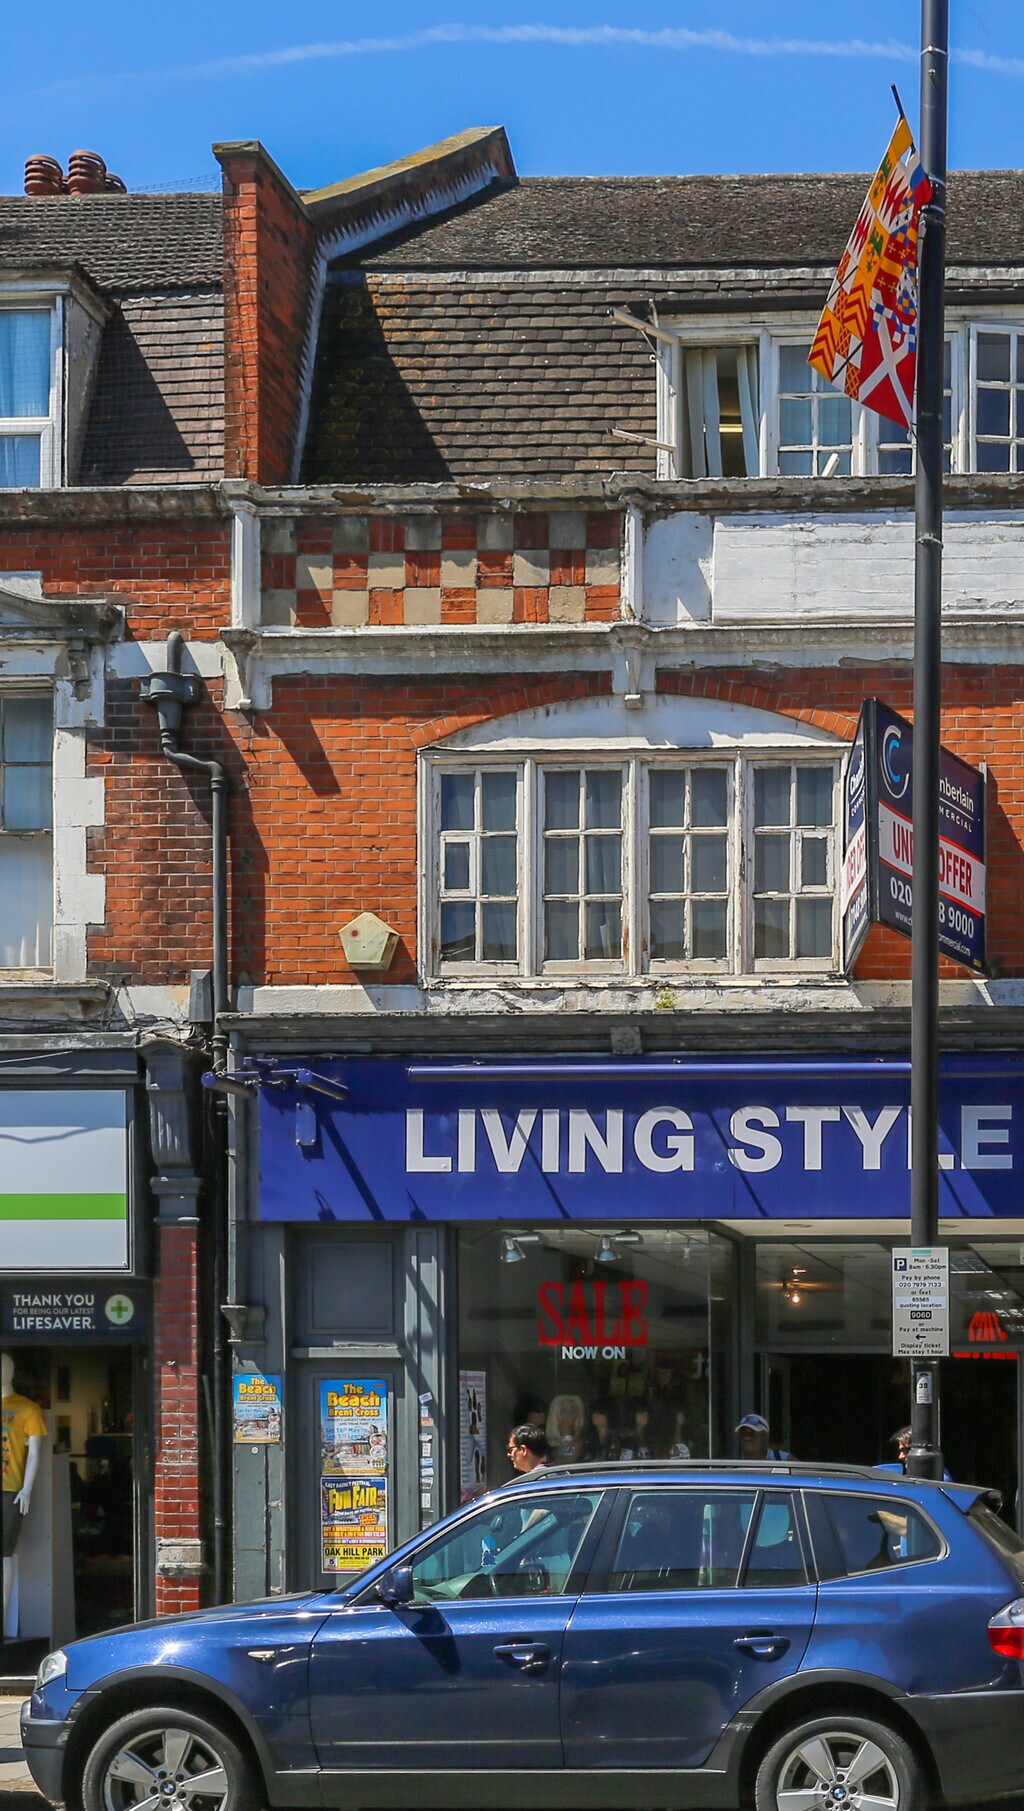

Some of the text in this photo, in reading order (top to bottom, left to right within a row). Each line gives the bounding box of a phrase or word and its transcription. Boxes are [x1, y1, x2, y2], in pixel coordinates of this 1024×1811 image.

[939, 777, 974, 813] mberlain
[938, 806, 973, 833] MERCIAL
[890, 876, 912, 907] 020
[948, 906, 974, 939] 9000
[405, 1106, 694, 1174] LIVING
[896, 1259, 905, 1270] P
[13, 1294, 95, 1306] THANK YOU
[13, 1307, 94, 1315] FOR BEING OUR LATEST
[537, 1280, 648, 1346] SALE
[13, 1316, 96, 1330] LIFESAVER.
[561, 1346, 626, 1360] NOW ON
[238, 1383, 277, 1394] Beach
[343, 1383, 364, 1394] The
[326, 1390, 381, 1407] Beach
[328, 1408, 379, 1417] Brent Cross
[325, 1548, 383, 1556] OAK HILL PARK
